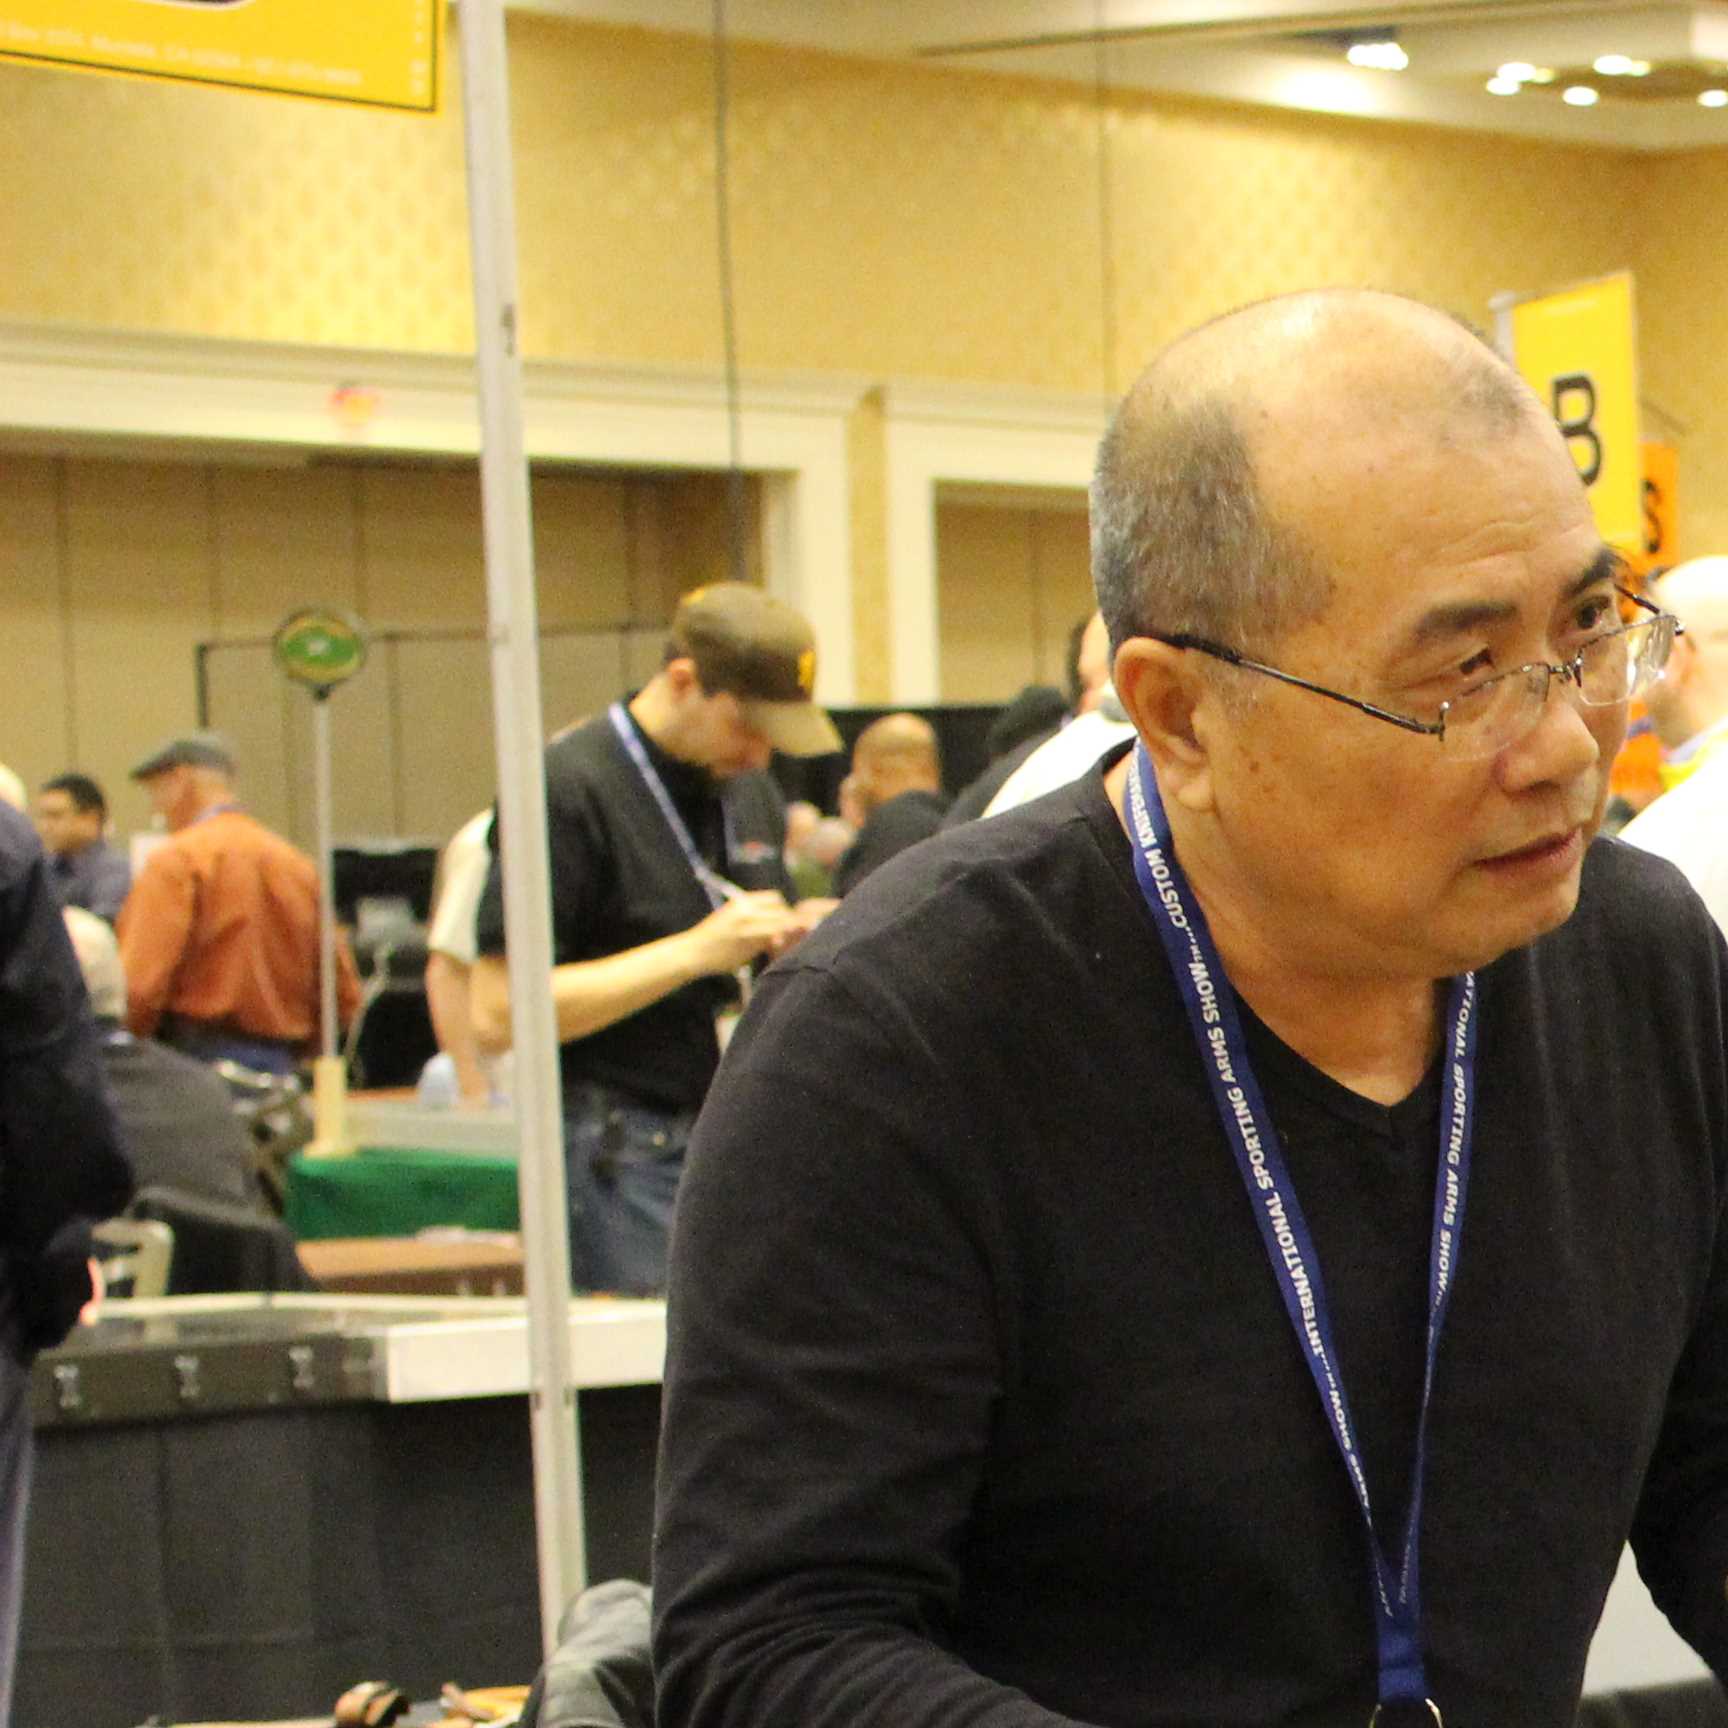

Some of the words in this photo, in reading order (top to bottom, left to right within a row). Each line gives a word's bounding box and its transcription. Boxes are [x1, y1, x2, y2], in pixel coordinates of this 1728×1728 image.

[1206, 1025, 1237, 1086] ARMS
[1226, 1088, 1274, 1190] SPORTING
[1447, 1065, 1465, 1164] SPORTING
[1442, 1168, 1459, 1227] ARMS
